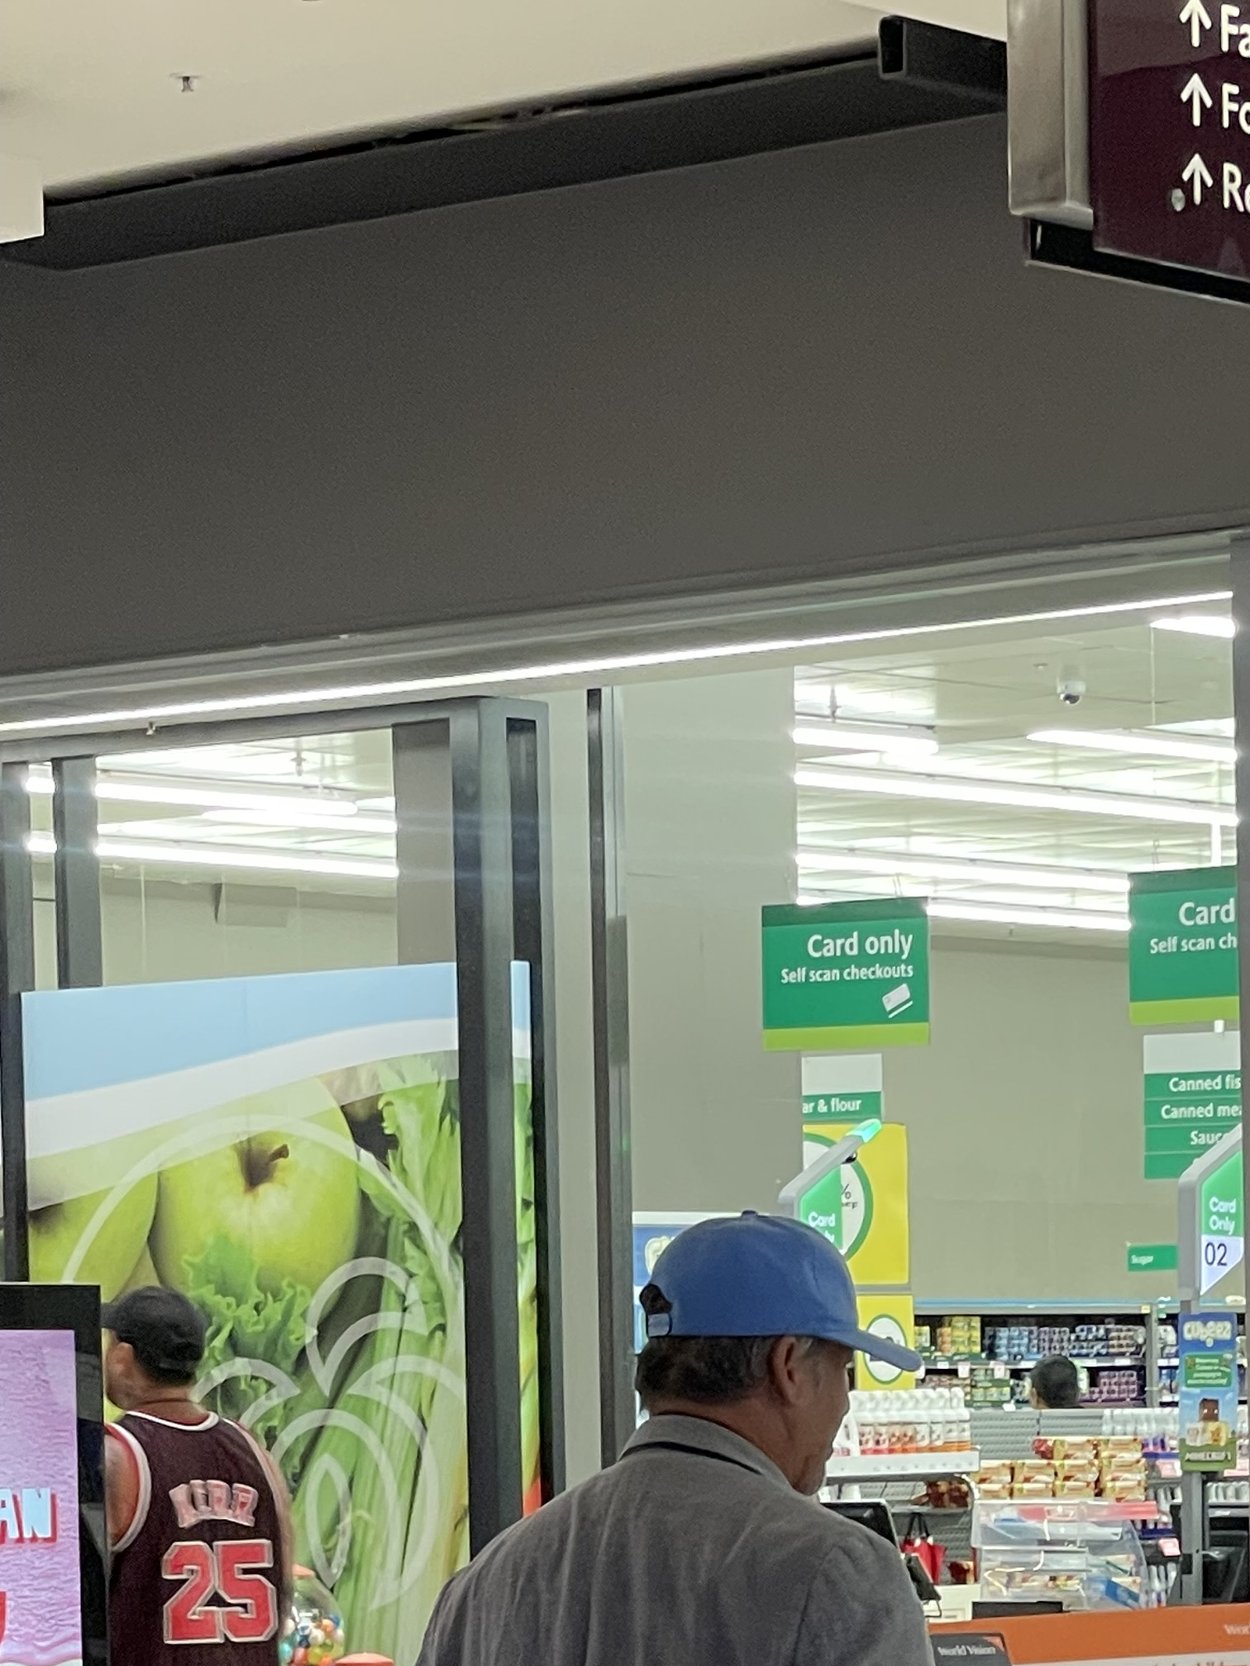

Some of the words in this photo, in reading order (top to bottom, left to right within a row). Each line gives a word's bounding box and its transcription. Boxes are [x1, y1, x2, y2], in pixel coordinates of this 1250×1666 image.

[1179, 898, 1235, 927] Card
[807, 932, 859, 959] Card
[864, 928, 913, 959] only
[1150, 937, 1177, 954] Self
[1180, 938, 1214, 952] scan
[781, 966, 807, 984] Self
[809, 968, 840, 983] scan
[843, 963, 914, 982] checkouts
[1169, 1076, 1221, 1092] Canned
[817, 1099, 828, 1113] &
[831, 1097, 862, 1112] flour
[1161, 1103, 1214, 1119] Canned
[1209, 1196, 1236, 1213] Card
[808, 1211, 836, 1228] Card
[1209, 1215, 1235, 1235] Only
[1204, 1242, 1227, 1266] 02
[161, 1538, 278, 1644] 25
